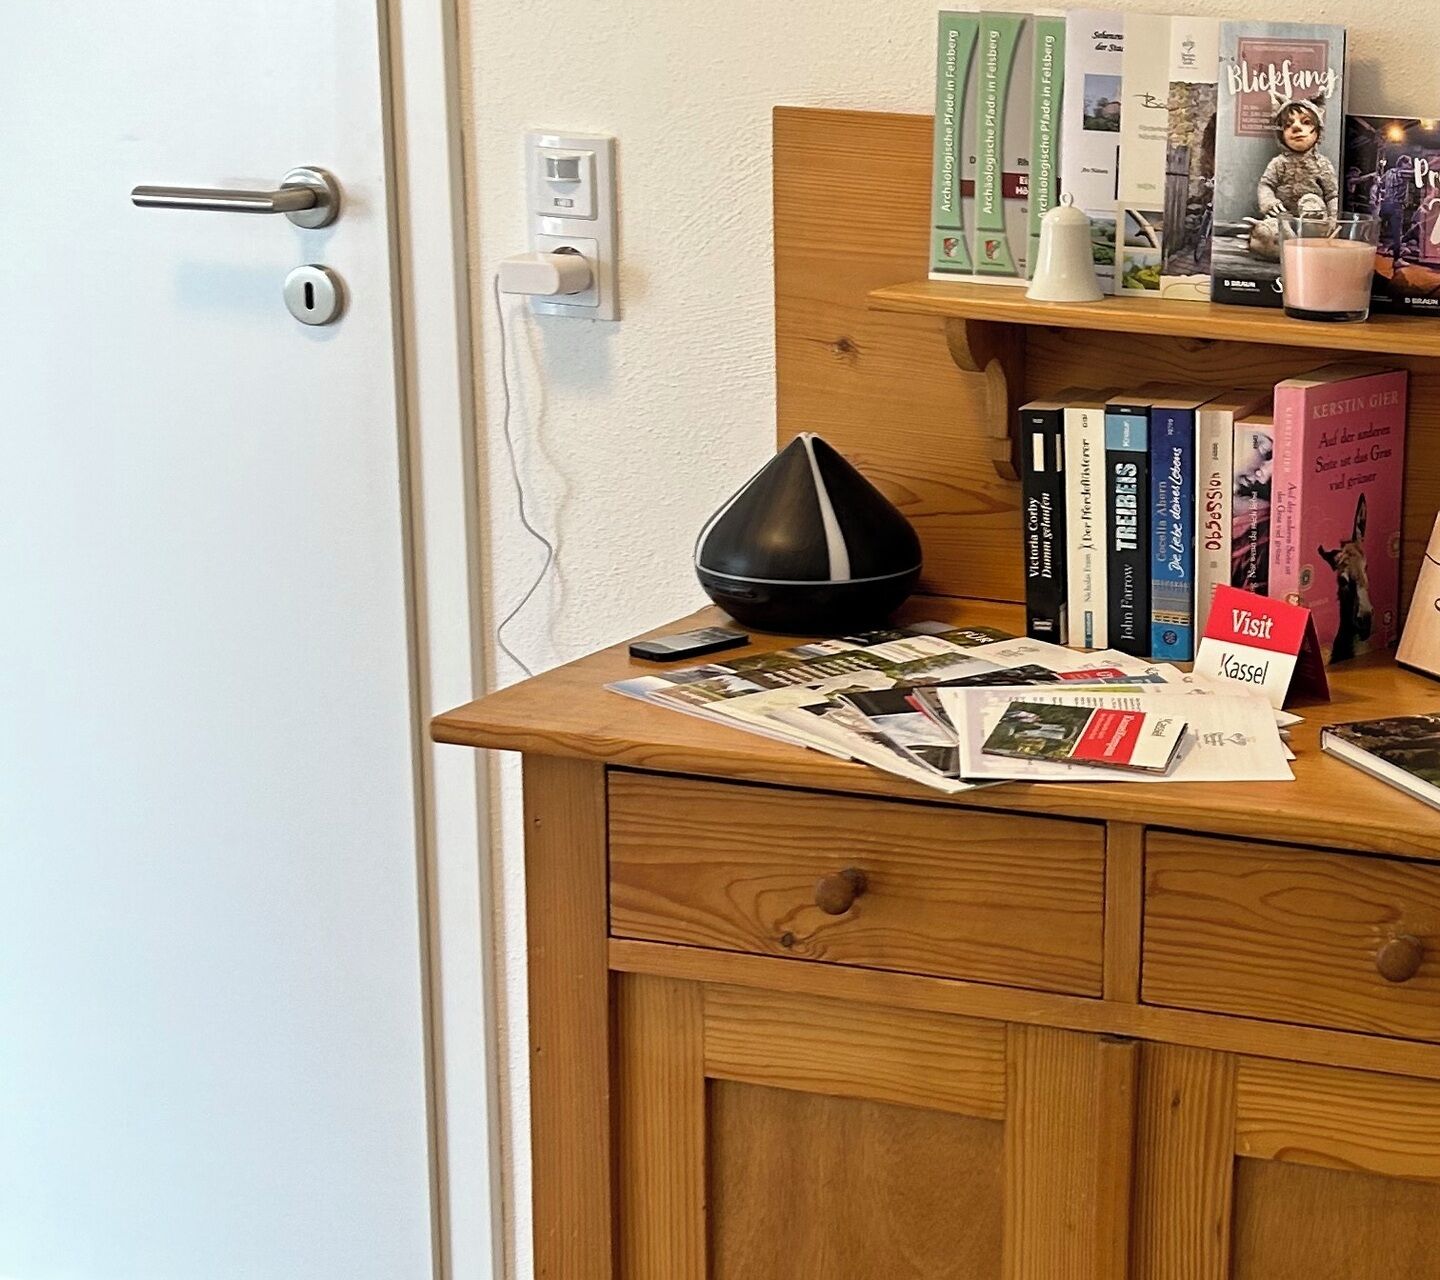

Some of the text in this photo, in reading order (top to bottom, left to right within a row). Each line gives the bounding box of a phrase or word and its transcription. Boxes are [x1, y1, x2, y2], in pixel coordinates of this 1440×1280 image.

[945, 30, 959, 79] Felsberg
[986, 30, 1000, 79] Felsberg
[1042, 35, 1056, 83] Felsberg
[1227, 59, 1339, 99] Blickfang
[944, 96, 956, 127] Pfade
[985, 96, 998, 127] Pfade
[1040, 100, 1053, 131] Pfade
[941, 129, 957, 212] Archäologische
[983, 129, 998, 214] Archäologische
[1037, 132, 1053, 218] Archäologische
[1313, 390, 1399, 419] KERSTIN GIER
[1121, 420, 1131, 448] Knaur
[1319, 422, 1391, 448] Auf der anderen
[1169, 447, 1183, 484] Lebens
[1354, 448, 1368, 463] das
[1370, 444, 1392, 461] Gras
[1156, 481, 1168, 517] Ahern
[1169, 485, 1182, 520] deines
[1287, 482, 1297, 499] Auf
[1115, 463, 1138, 551] TREIBEIS
[1287, 501, 1297, 513] der
[1028, 496, 1041, 578] Victoria Corby
[1041, 492, 1053, 579] Dumm gelaufen
[1082, 522, 1092, 542] Der
[1168, 523, 1183, 553] Liebe
[1285, 516, 1295, 544] anderen
[1168, 554, 1184, 577] Die
[1121, 563, 1135, 640] John Farrow
[1232, 609, 1274, 639] Visit
[1218, 653, 1269, 685] Kassel
